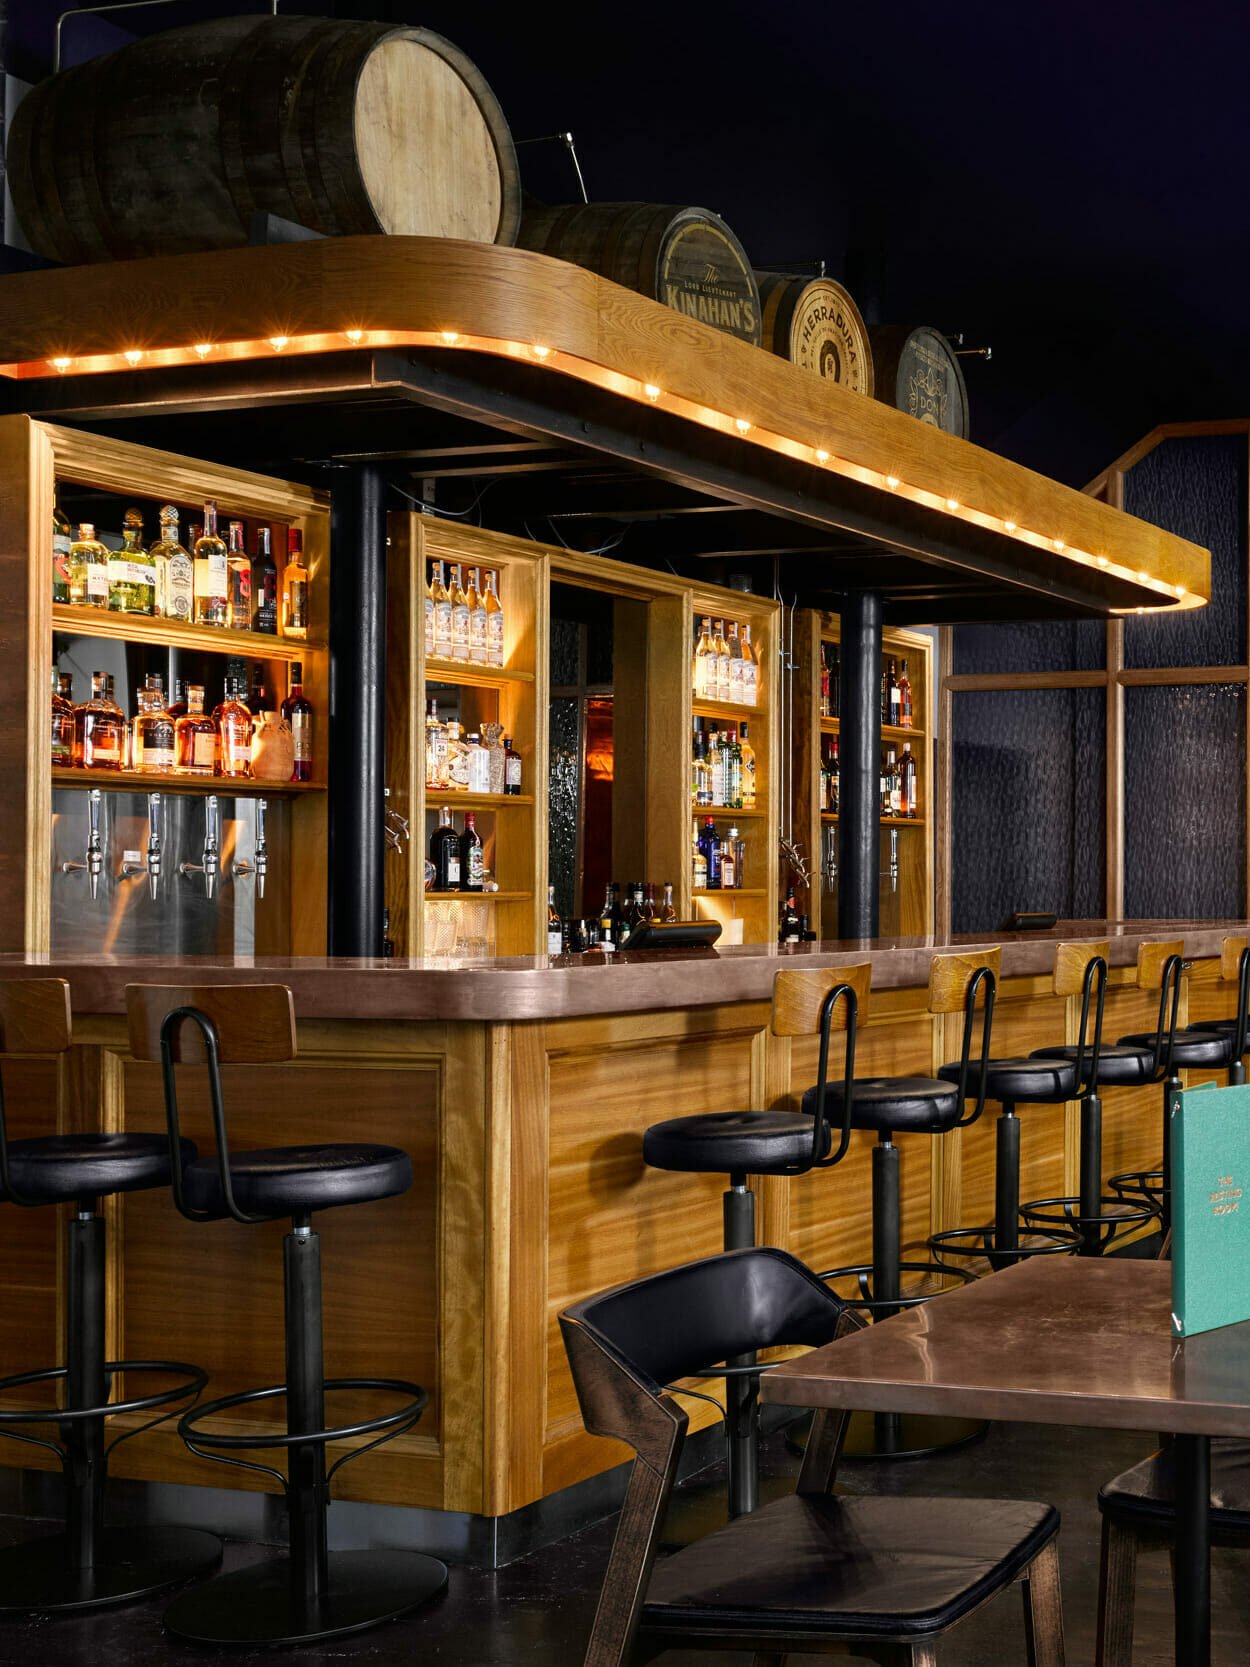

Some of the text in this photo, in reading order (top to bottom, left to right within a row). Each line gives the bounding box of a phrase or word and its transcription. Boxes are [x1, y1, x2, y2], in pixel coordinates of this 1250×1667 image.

[703, 263, 719, 283] The
[665, 284, 756, 333] KINAHAN'S
[802, 305, 857, 364] HERRADURA
[1217, 1175, 1233, 1187] THE
